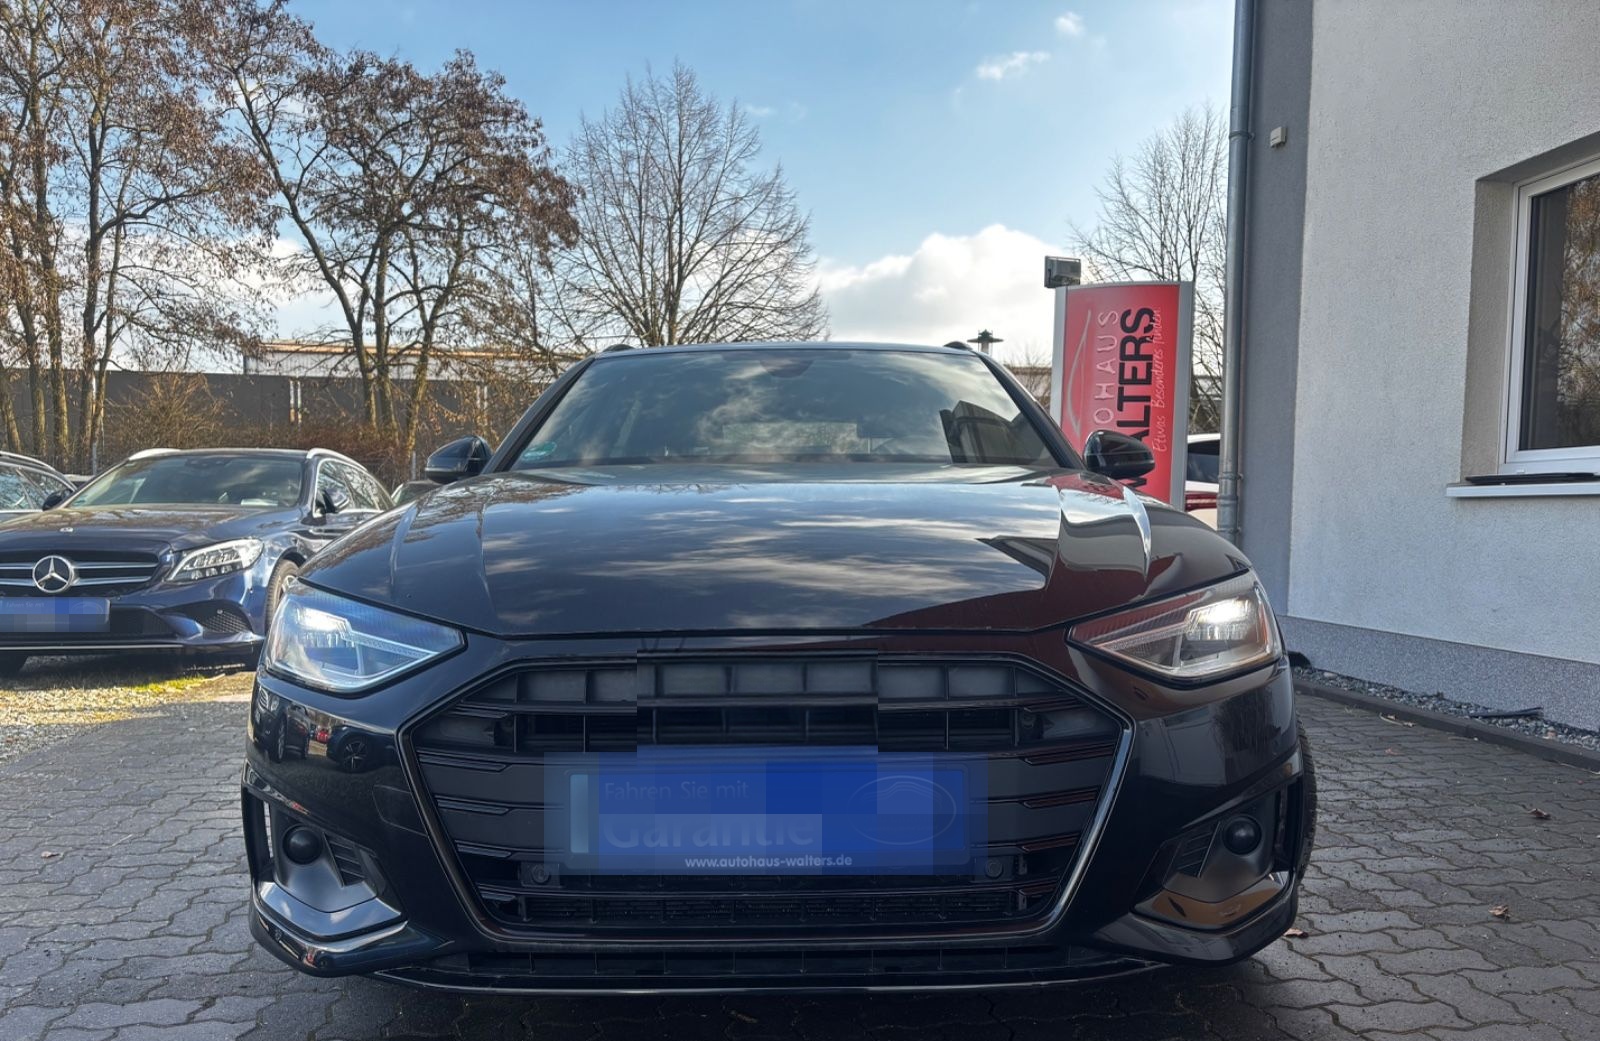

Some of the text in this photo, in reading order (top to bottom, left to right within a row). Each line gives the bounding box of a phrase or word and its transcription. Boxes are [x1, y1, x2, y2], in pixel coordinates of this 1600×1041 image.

[1093, 310, 1119, 425] OHAUS
[1150, 348, 1166, 409] Besonderes
[1152, 415, 1168, 452] Etwas
[604, 780, 749, 801] Fahren Sie mit
[684, 853, 853, 869] www.autohaus-walters.de
